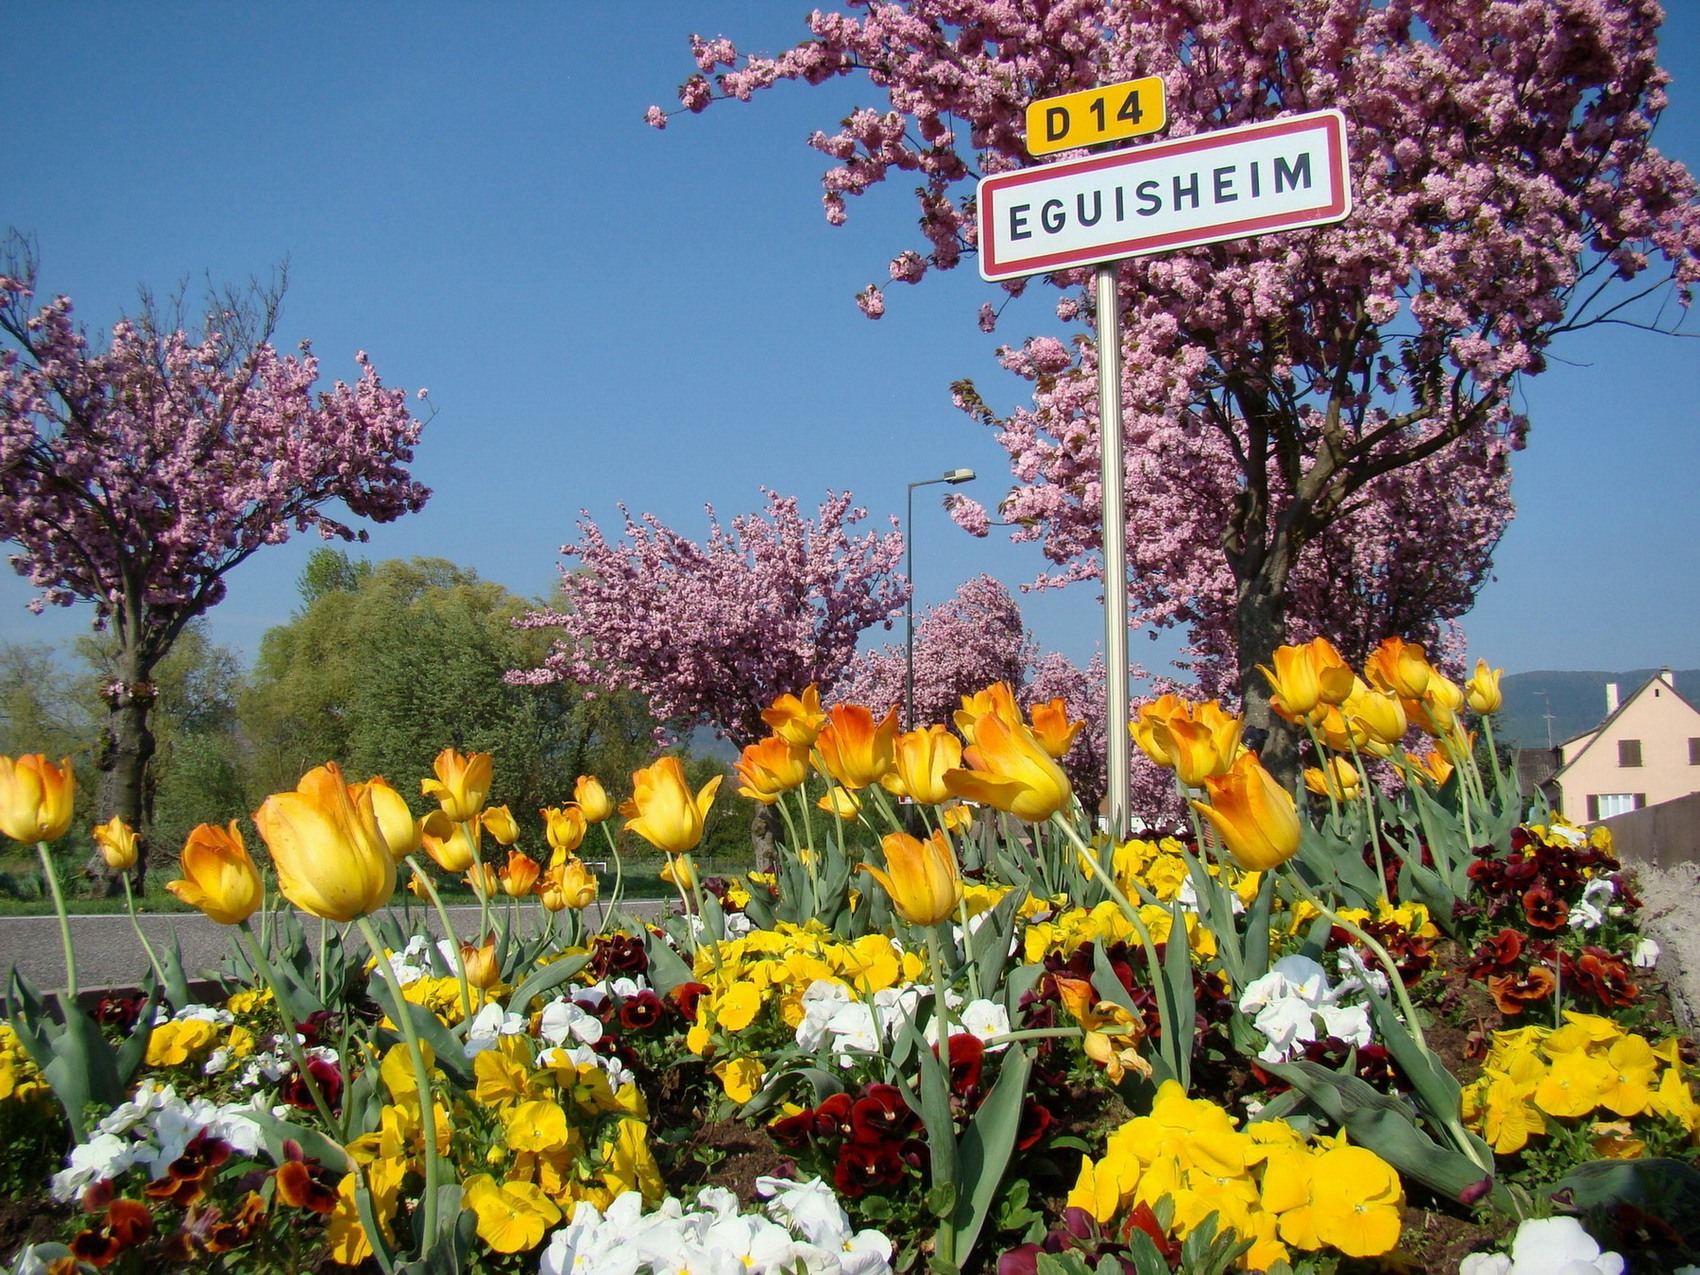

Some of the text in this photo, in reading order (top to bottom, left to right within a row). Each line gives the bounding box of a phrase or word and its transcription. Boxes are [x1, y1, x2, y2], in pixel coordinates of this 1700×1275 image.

[1046, 90, 1143, 142] D 14
[1009, 152, 1312, 241] EGUISHEIM
